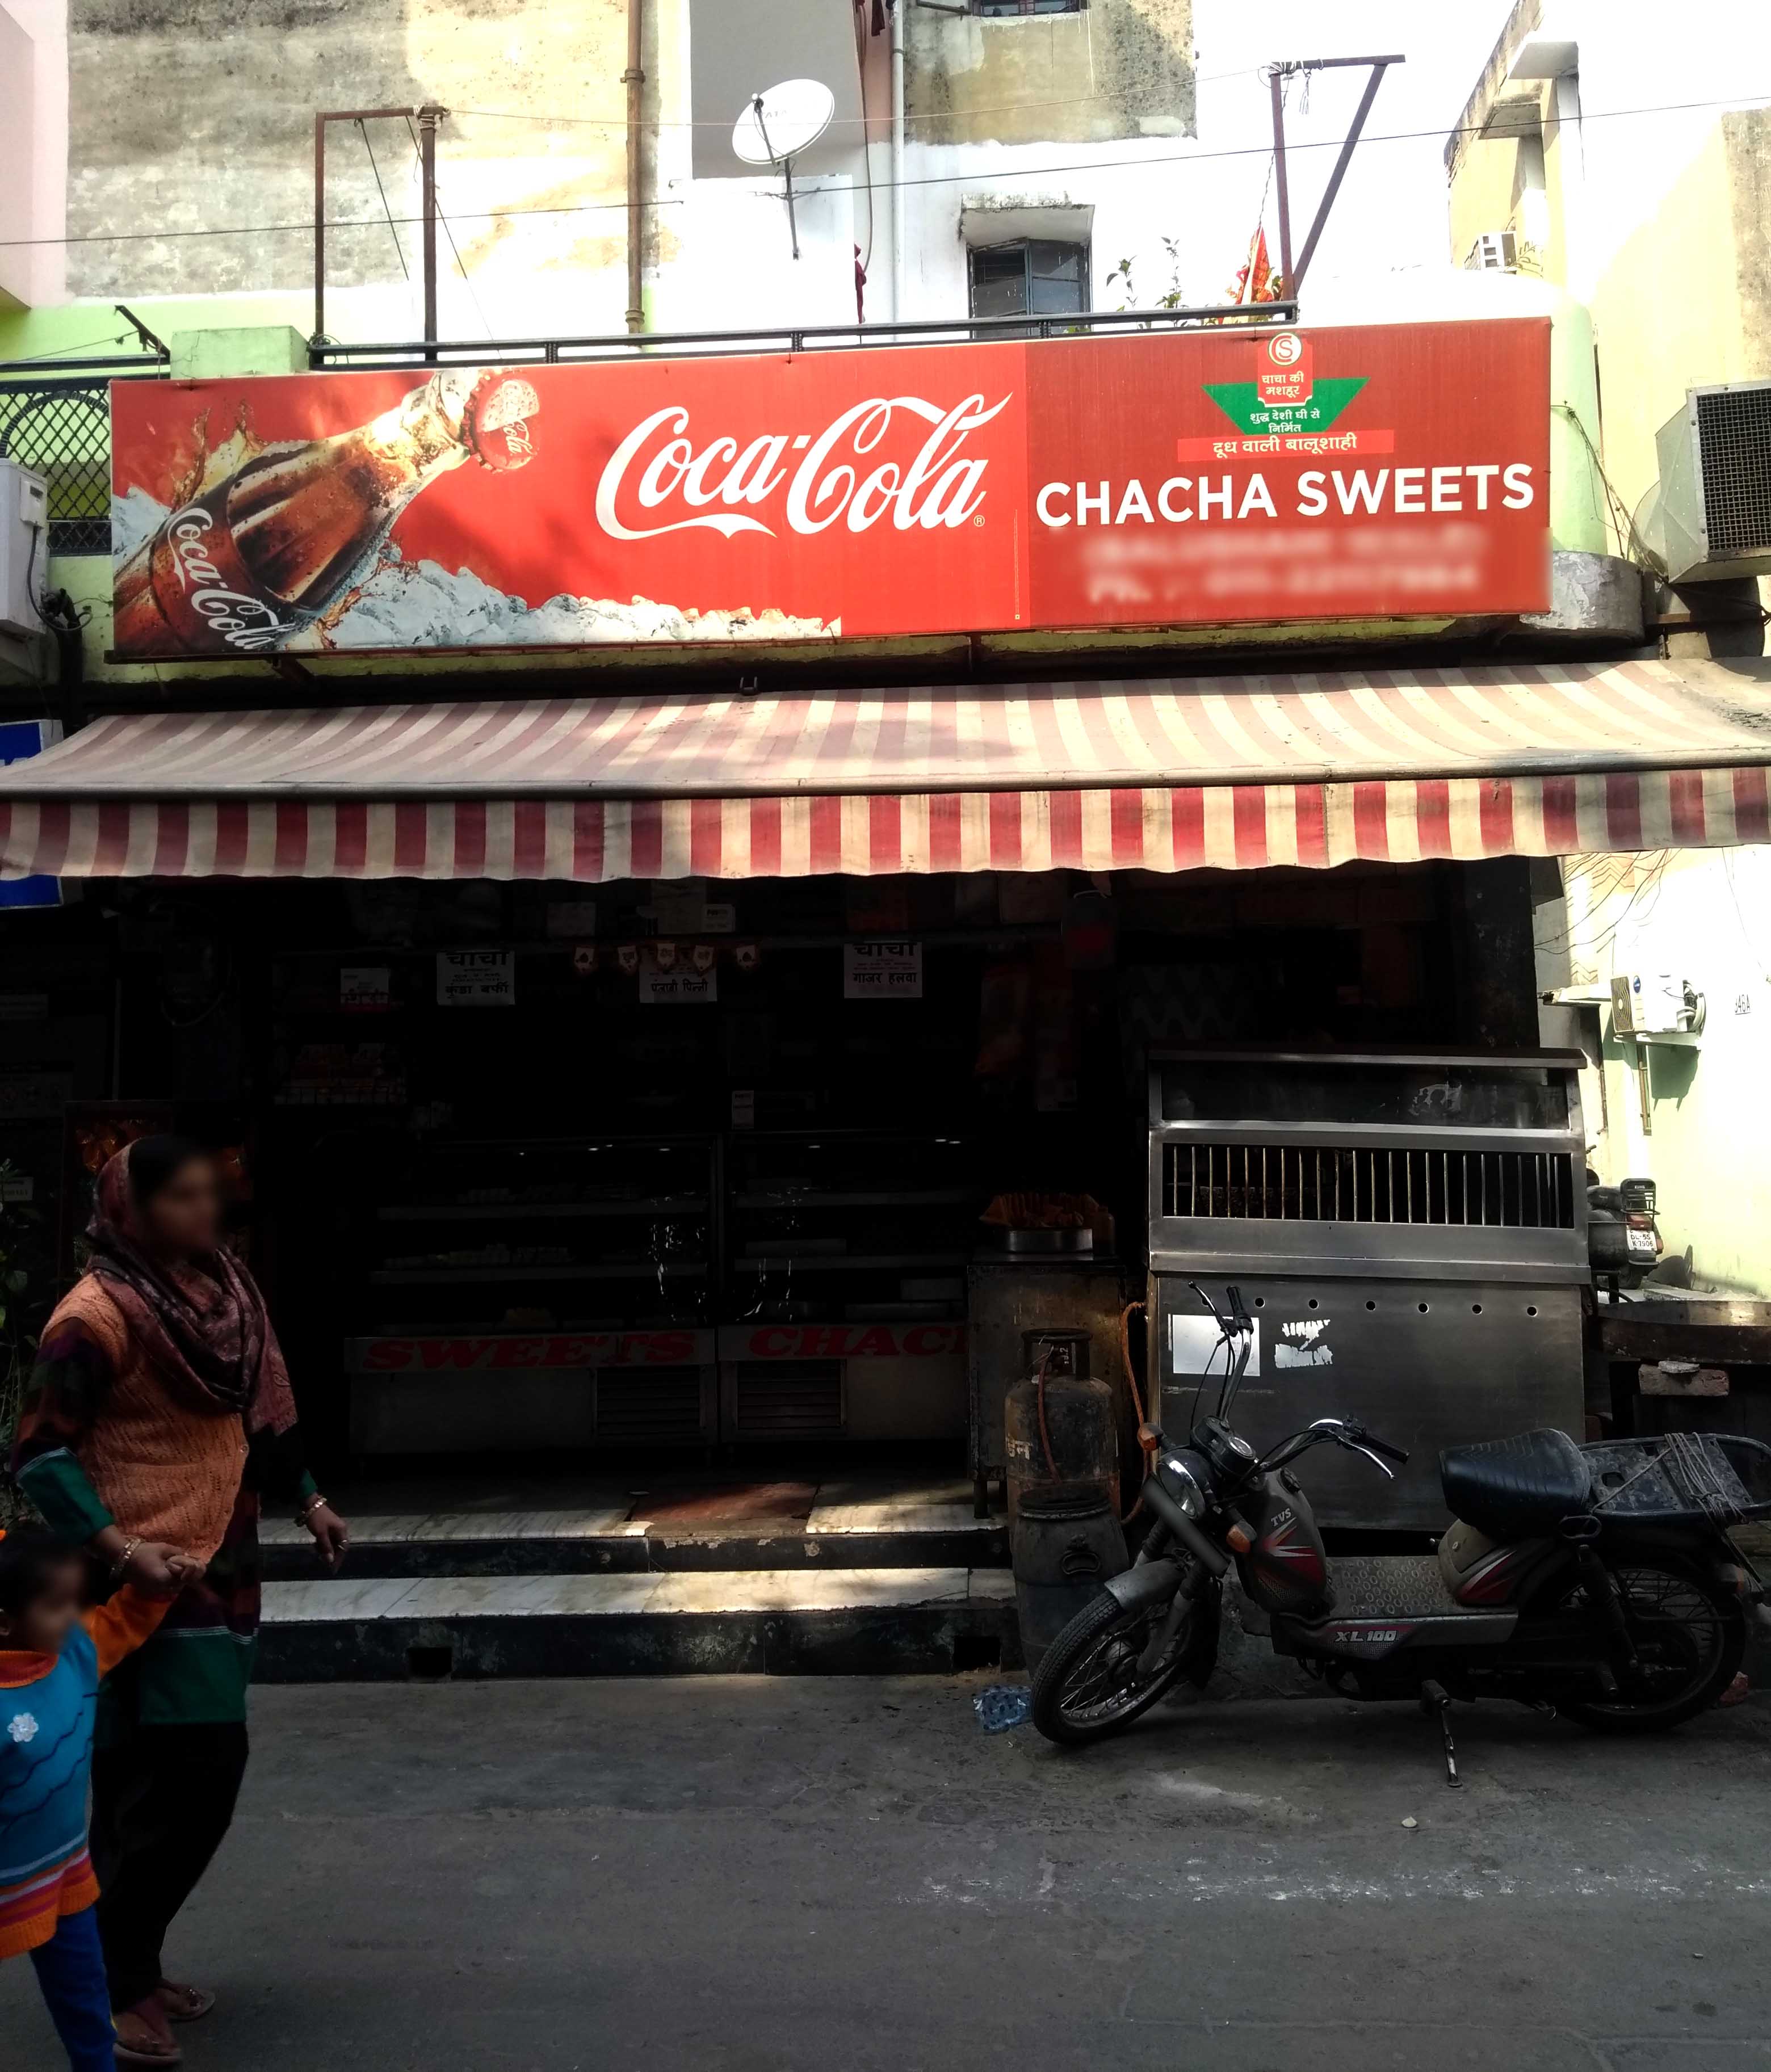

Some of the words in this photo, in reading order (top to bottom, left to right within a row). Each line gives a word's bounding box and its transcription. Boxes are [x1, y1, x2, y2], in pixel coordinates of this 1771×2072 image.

[1262, 373, 1286, 384] चाचा
[1289, 371, 1304, 383] की
[1265, 385, 1300, 398] मशहूर
[1249, 412, 1270, 425] शुद्ध
[1271, 409, 1292, 421] देशी
[1295, 407, 1308, 419] घी
[1310, 407, 1320, 419] से
[1268, 421, 1302, 434] निर्मित
[1213, 442, 1237, 458] दूध
[1242, 435, 1281, 452] वाली
[1285, 432, 1357, 455] बालूशाही
[595, 392, 1013, 540] Coca-Cola
[1036, 472, 1278, 527] CHACHA
[1296, 463, 1534, 517] SWEETS
[167, 507, 296, 650] Coca-Cola
[853, 943, 917, 956] चाचा
[446, 952, 509, 965] चाचा
[853, 972, 883, 984] गाजर
[888, 972, 917, 985] हलवा
[363, 1331, 695, 1369] SWEETS
[1271, 1508, 1292, 1527] TVS
[1335, 1631, 1363, 1642] XL
[1367, 1630, 1397, 1642] 100
